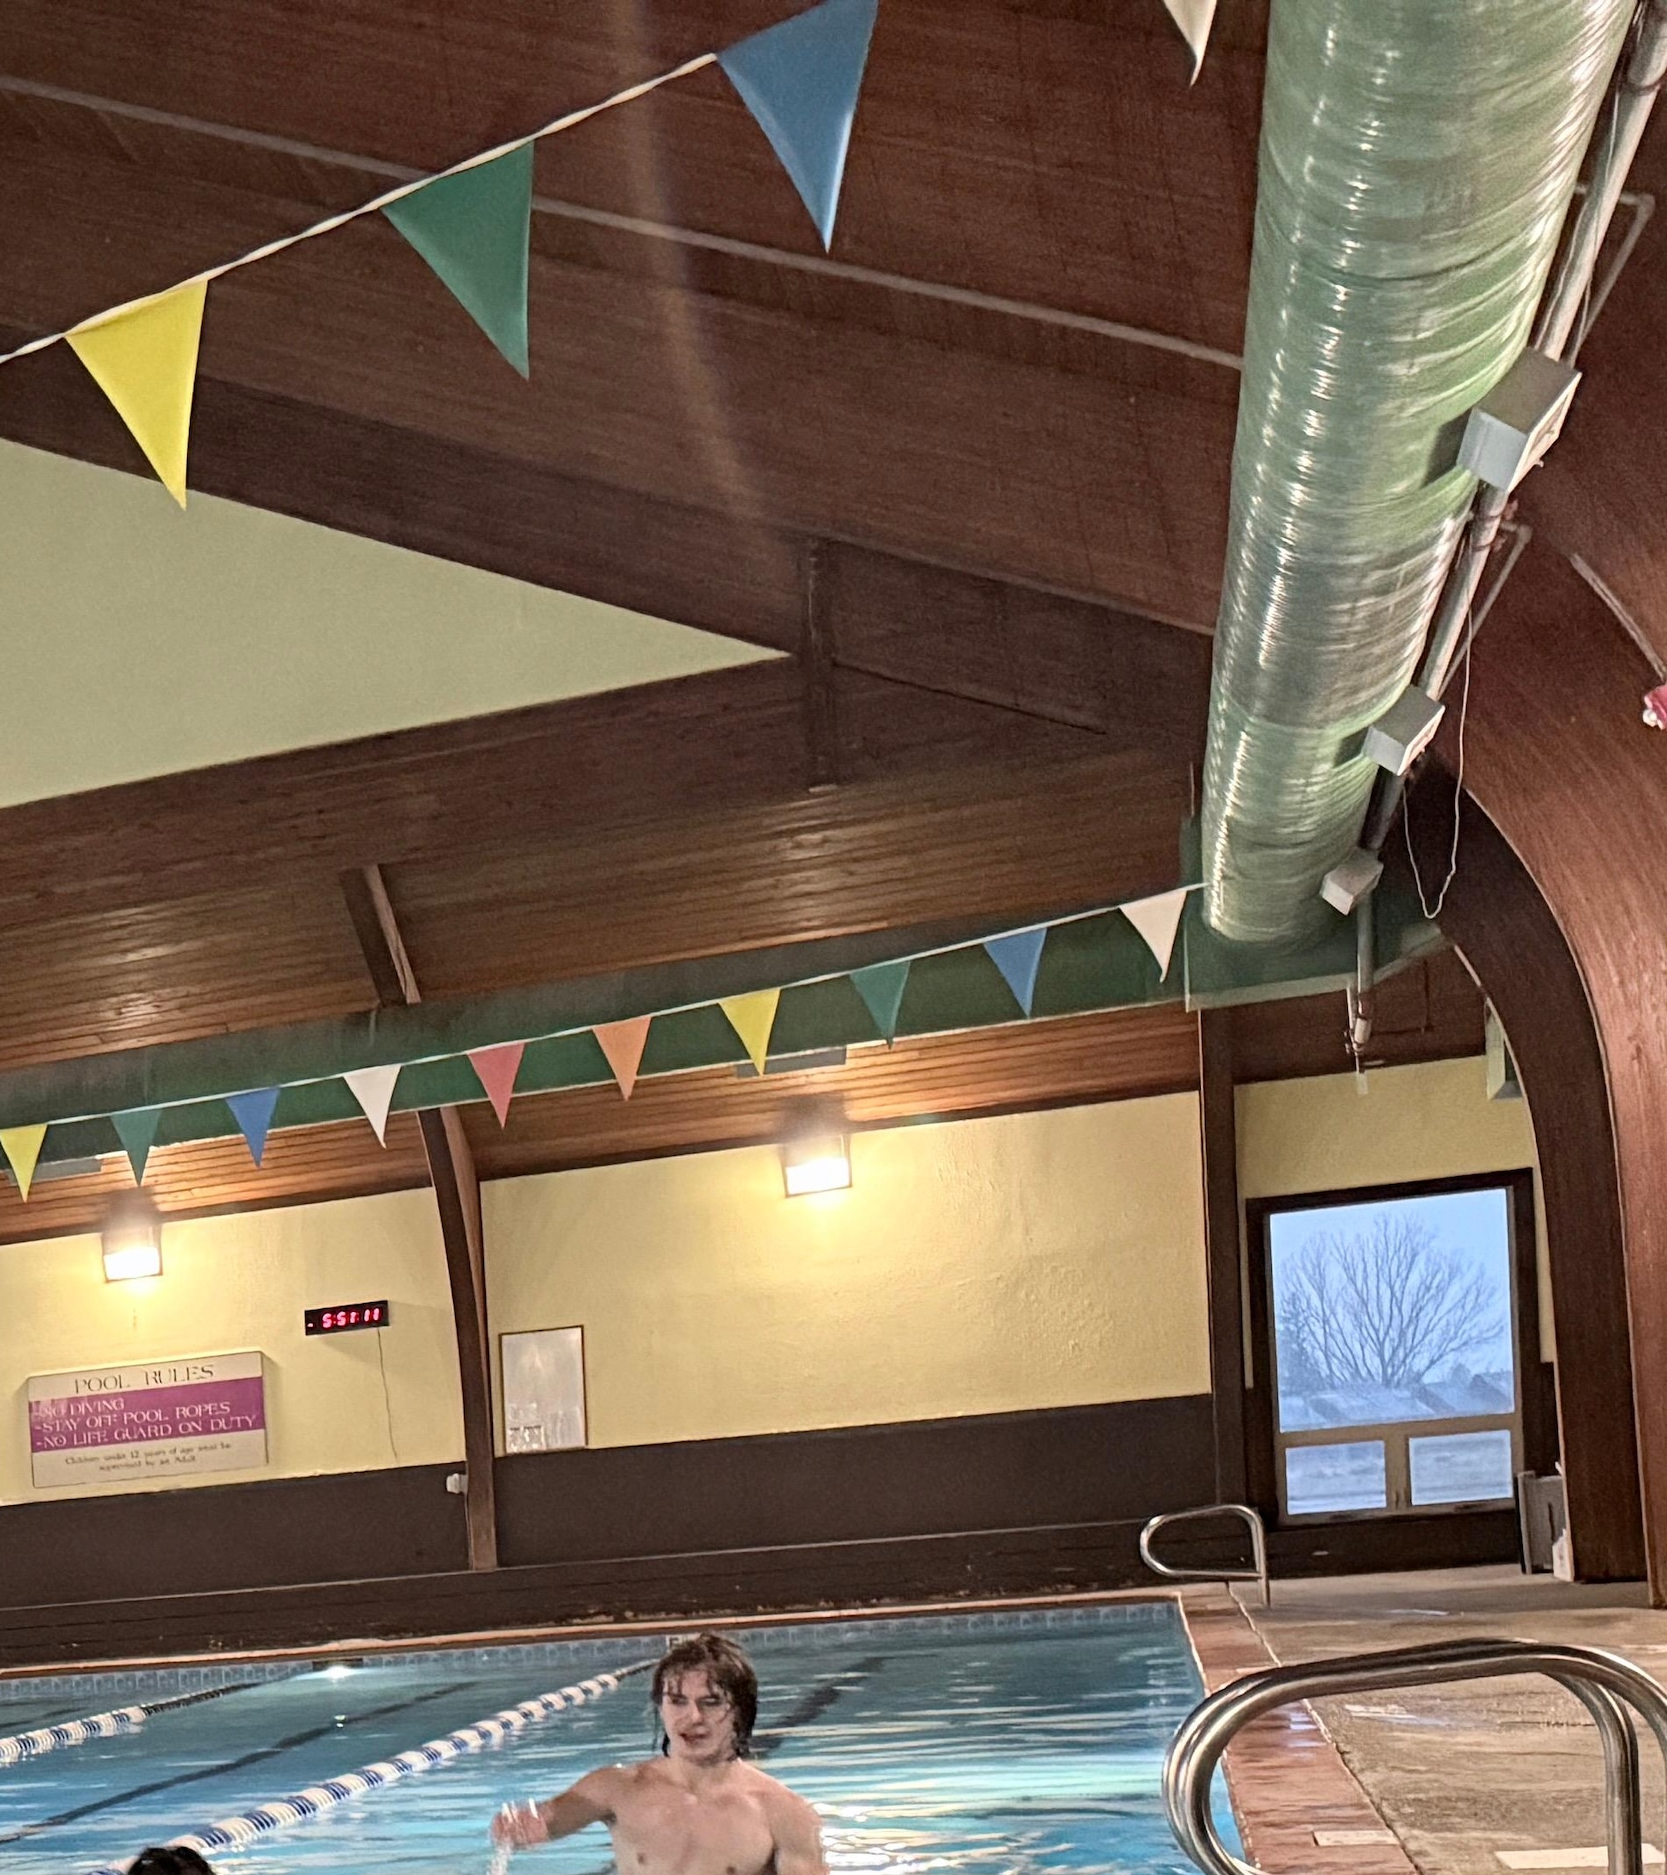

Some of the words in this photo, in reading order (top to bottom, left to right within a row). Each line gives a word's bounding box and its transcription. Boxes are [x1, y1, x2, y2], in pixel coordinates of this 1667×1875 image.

[75, 1375, 130, 1394] POOL
[145, 1365, 214, 1385] RULES
[70, 1398, 124, 1416] DIVING
[86, 1415, 117, 1429] OFF
[124, 1409, 169, 1425] POOL
[176, 1402, 231, 1419] ROPES
[73, 1430, 107, 1446] LIFE
[114, 1423, 172, 1441] GUARD
[179, 1420, 203, 1434] ON
[211, 1415, 256, 1431] DUTY
